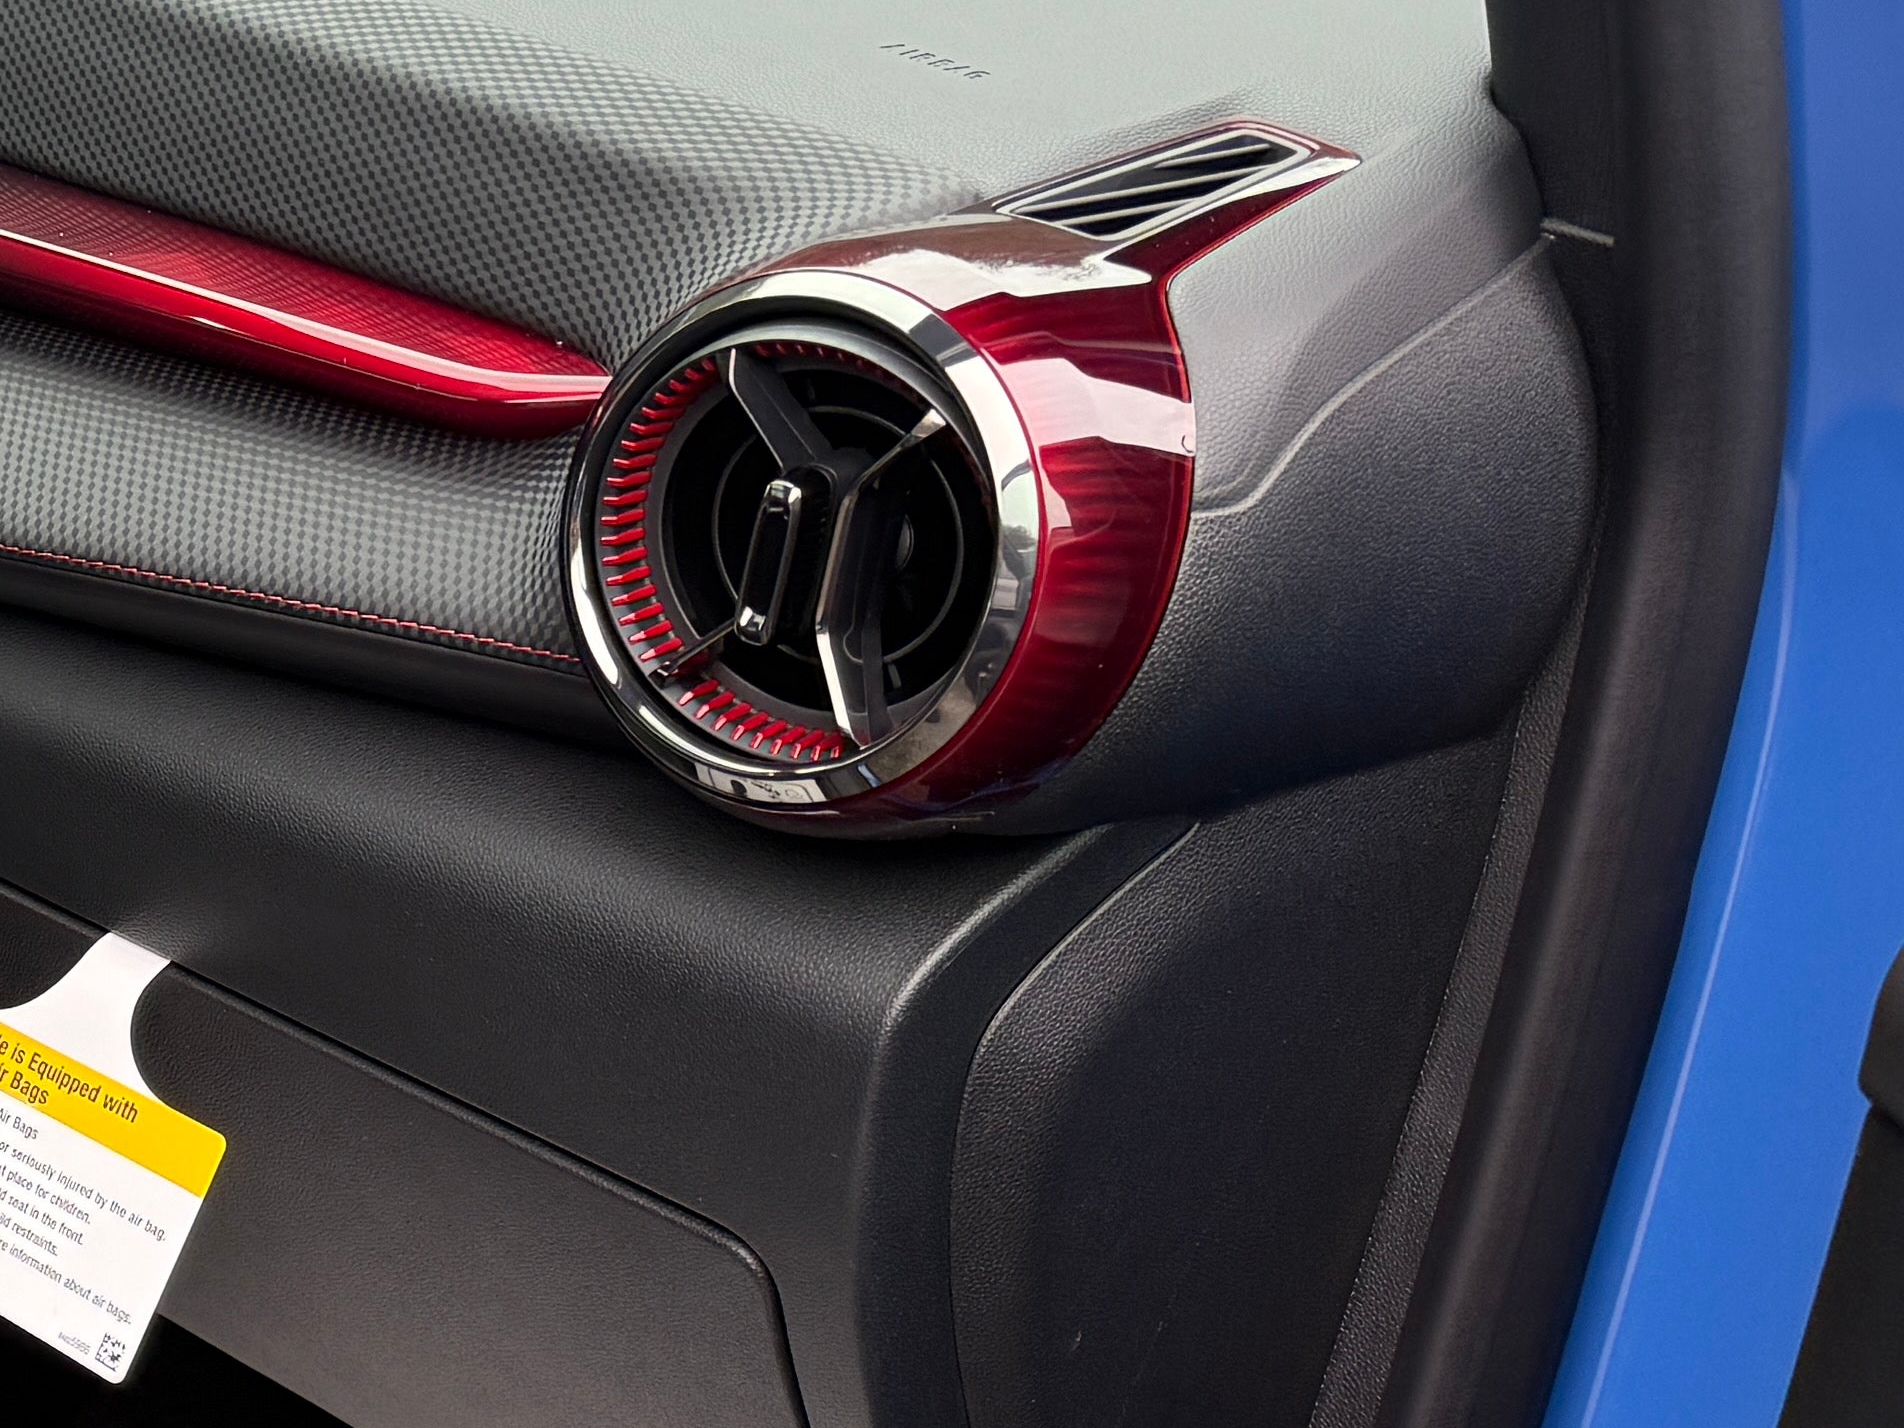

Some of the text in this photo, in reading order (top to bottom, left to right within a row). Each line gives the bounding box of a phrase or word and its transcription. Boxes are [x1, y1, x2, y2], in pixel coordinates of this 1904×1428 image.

[9, 1070, 50, 1105] Bags
[10, 1042, 26, 1065] is
[27, 1051, 102, 1103] Equipped
[102, 1093, 138, 1124] with
[12, 1115, 39, 1140] Bags
[5, 1170, 34, 1191] place
[34, 1183, 50, 1200] for
[49, 1194, 91, 1225] children.
[7, 1195, 30, 1215] seat
[29, 1206, 40, 1220] in
[40, 1212, 57, 1230] the
[58, 1222, 84, 1246] front.
[10, 1148, 57, 1181] seriously
[56, 1170, 94, 1200] injured
[94, 1191, 109, 1210] by
[109, 1200, 127, 1219] the
[127, 1212, 144, 1227] air
[144, 1219, 166, 1242] bag.
[11, 1222, 58, 1257] restraints.
[8, 1243, 63, 1284] information
[63, 1277, 92, 1301] about
[91, 1294, 106, 1308] air
[105, 1300, 132, 1325] bags.
